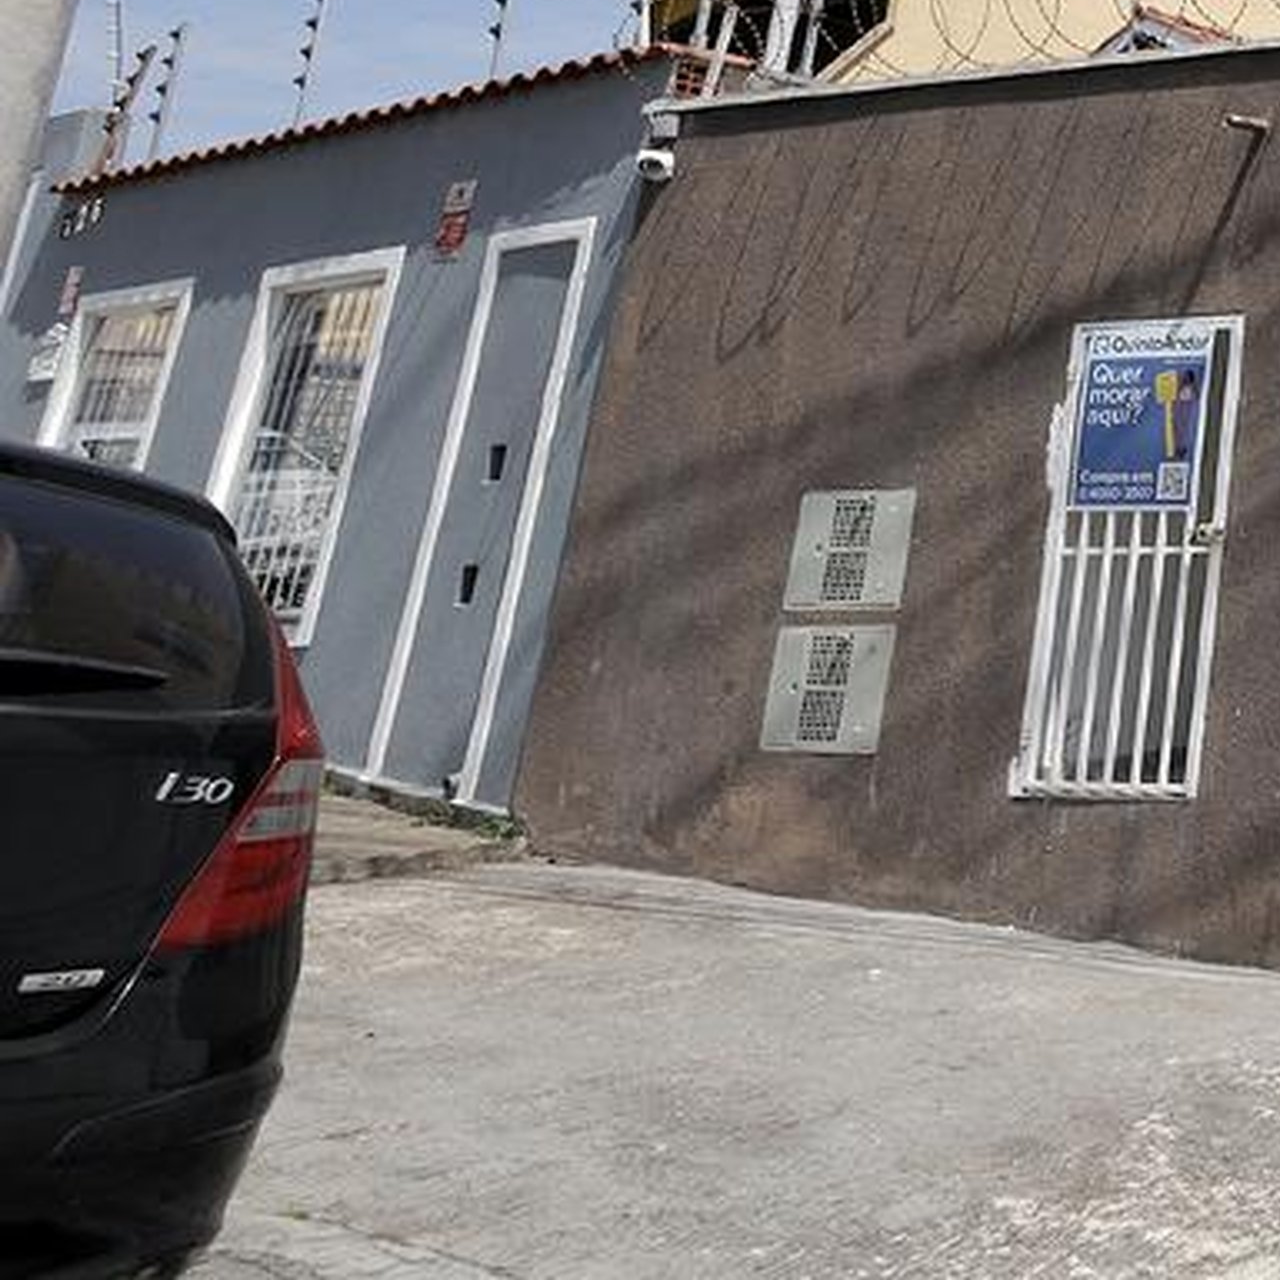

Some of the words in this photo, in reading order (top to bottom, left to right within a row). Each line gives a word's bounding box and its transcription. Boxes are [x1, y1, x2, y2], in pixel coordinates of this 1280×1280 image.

[1092, 362, 1144, 384] Quer
[1089, 387, 1151, 405] morar
[1086, 403, 1143, 428] aqui?
